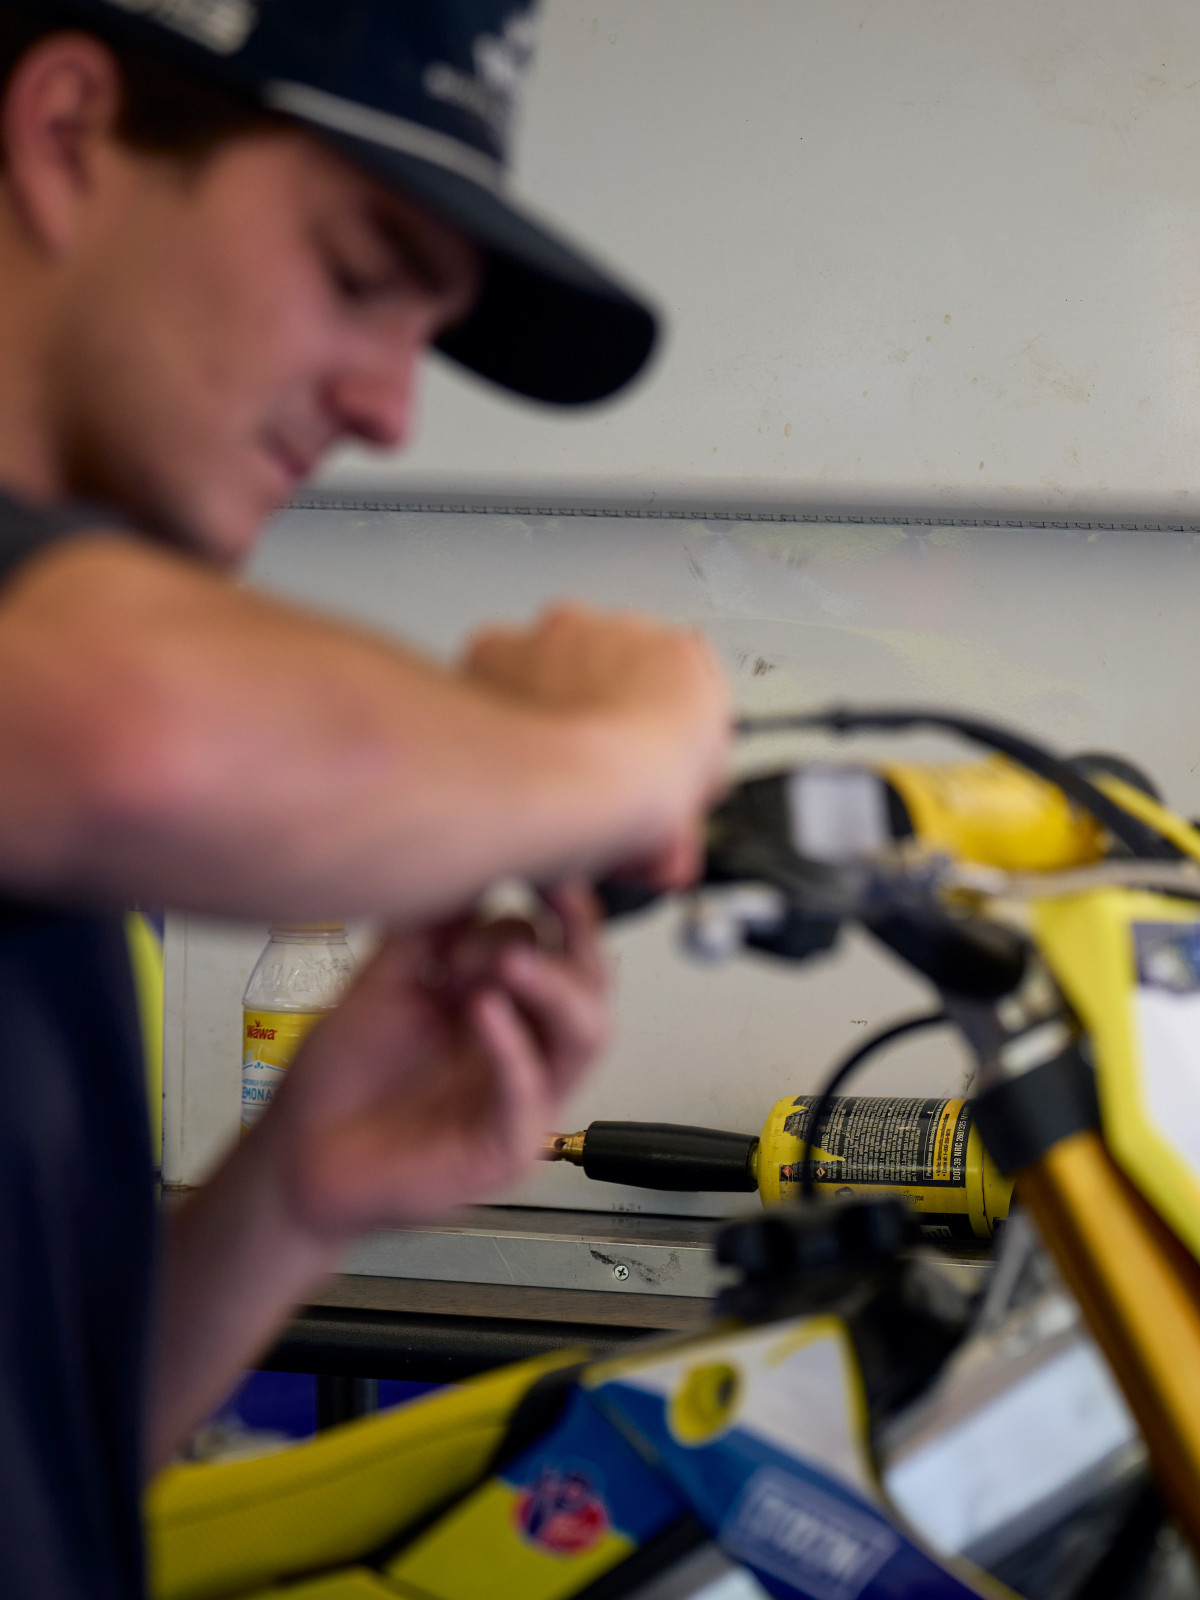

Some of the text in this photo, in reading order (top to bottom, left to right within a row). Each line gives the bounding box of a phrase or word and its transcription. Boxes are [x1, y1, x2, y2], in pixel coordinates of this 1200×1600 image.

[246, 1025, 275, 1041] Wawa
[953, 1142, 963, 1158] NRC
[953, 1160, 962, 1181] DOT-39
